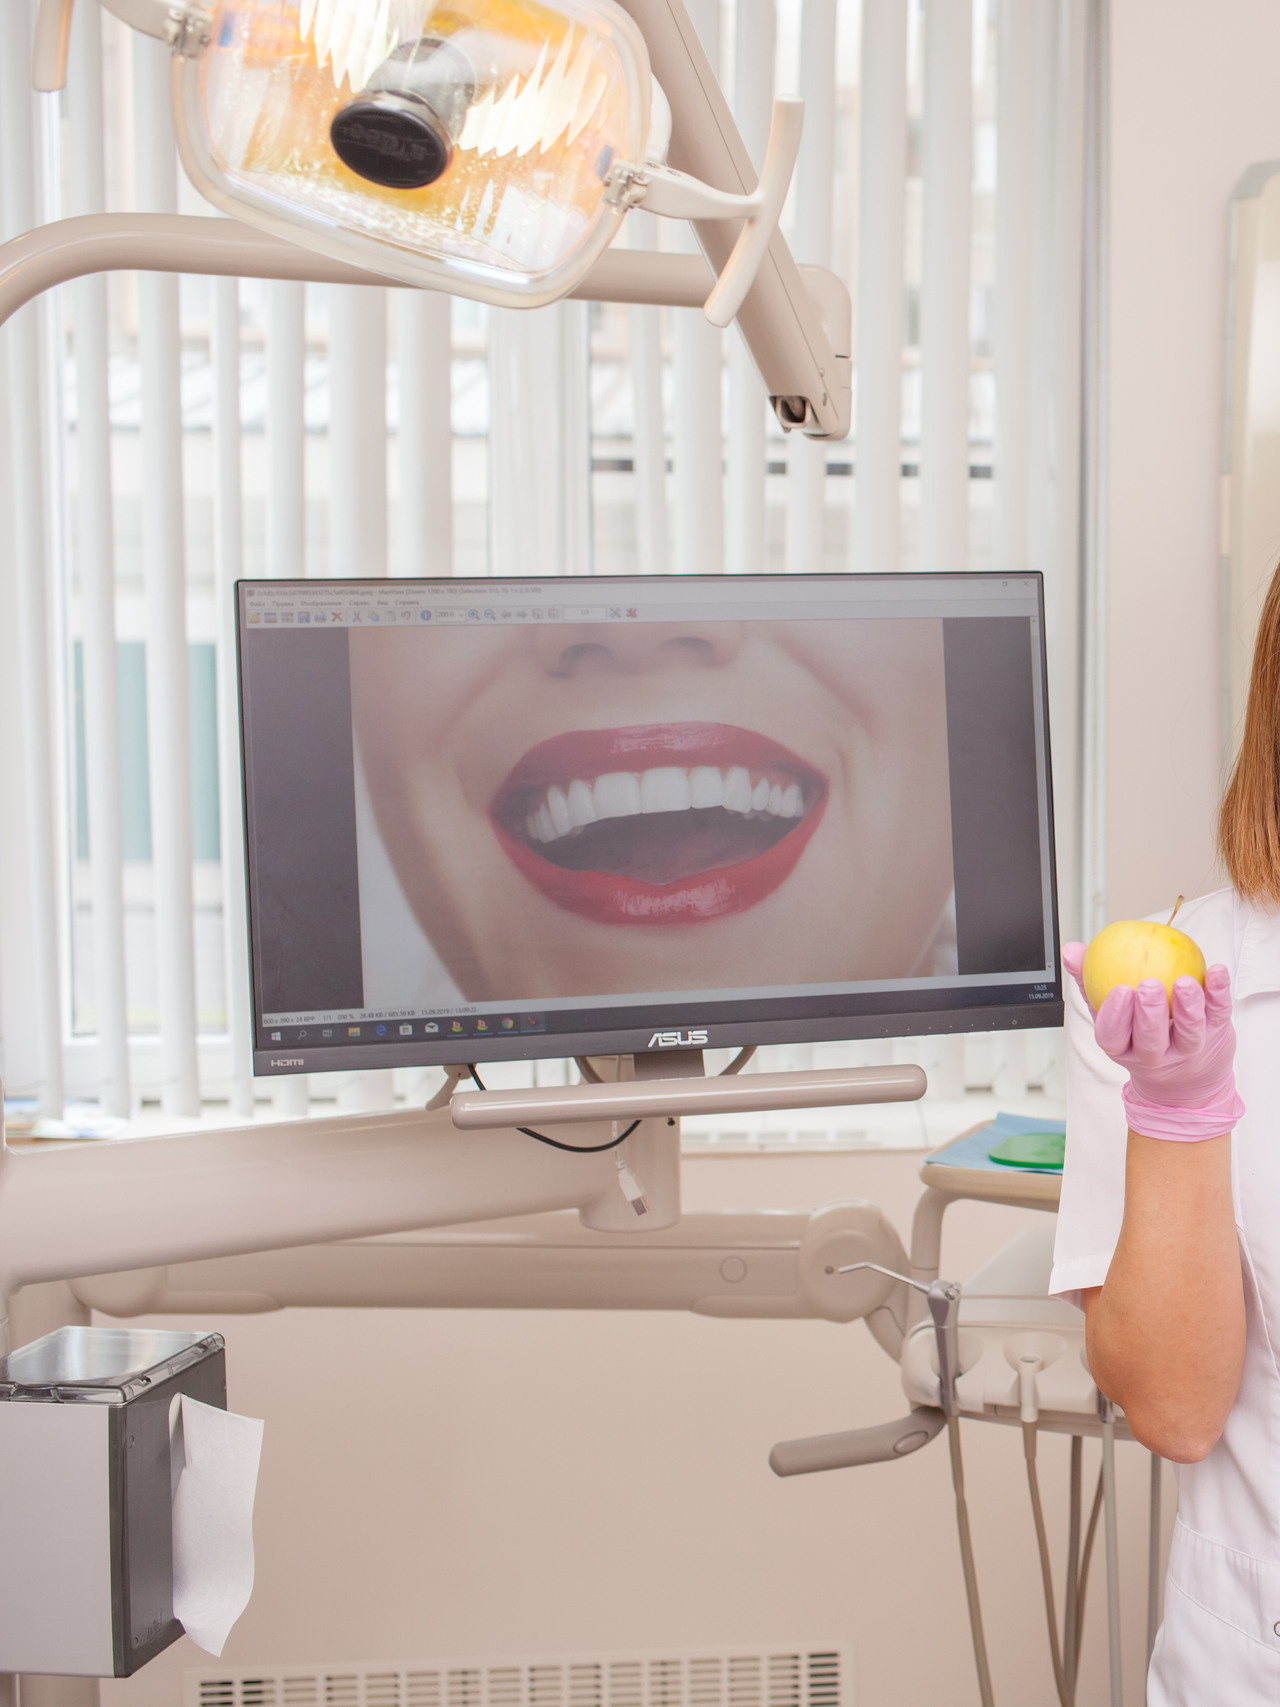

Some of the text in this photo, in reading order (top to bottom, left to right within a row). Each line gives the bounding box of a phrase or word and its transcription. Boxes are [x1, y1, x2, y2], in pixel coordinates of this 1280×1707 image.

[272, 600, 294, 608] Правка
[301, 600, 342, 608] Изображение
[648, 1030, 709, 1047] ASUS
[270, 1058, 304, 1067] HDMI
